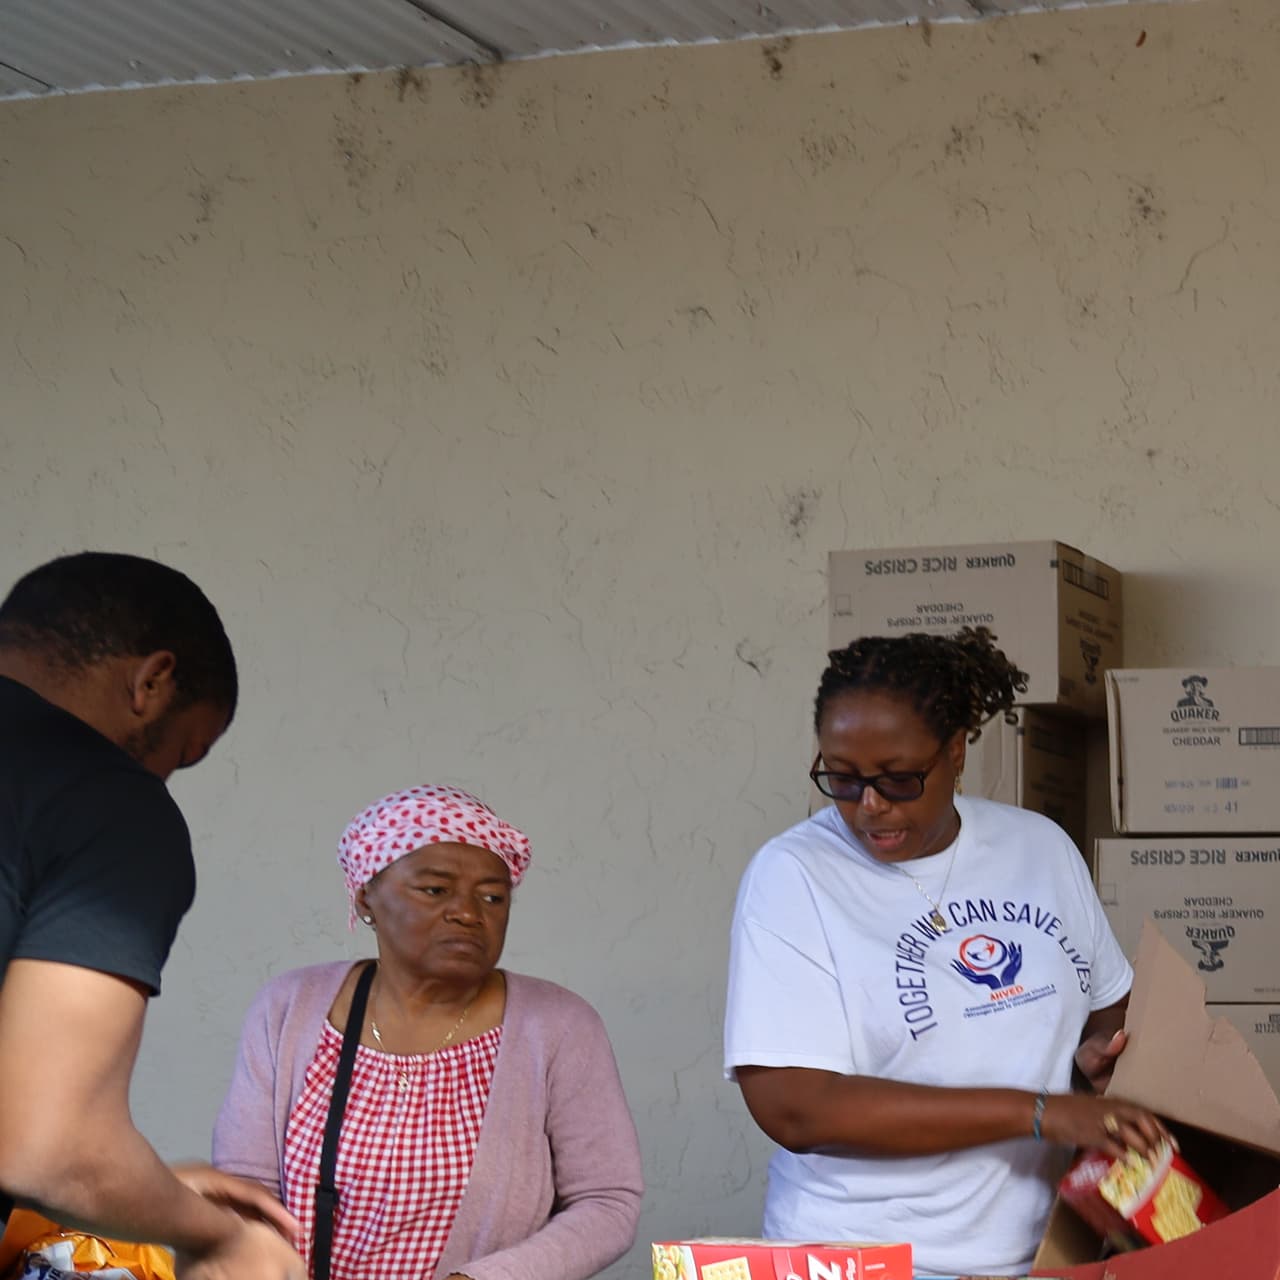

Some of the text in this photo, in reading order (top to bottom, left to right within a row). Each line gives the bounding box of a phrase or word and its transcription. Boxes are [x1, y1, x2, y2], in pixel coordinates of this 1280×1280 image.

[864, 553, 1016, 576] QUAKER RICE CRISPS
[915, 602, 964, 614] CHEDDAR
[1170, 704, 1221, 723] QUAKER
[1172, 736, 1222, 747] CHEDDAR
[1130, 849, 1186, 866] CRISPS
[1190, 849, 1227, 865] RICE
[1183, 896, 1233, 906] CHEDDAR
[1185, 925, 1236, 941] QUAKER
[895, 932, 938, 1042] TOGETHER
[948, 898, 998, 928] CAN
[1002, 900, 1063, 938] SAVE
[1058, 935, 1093, 996] LIVES
